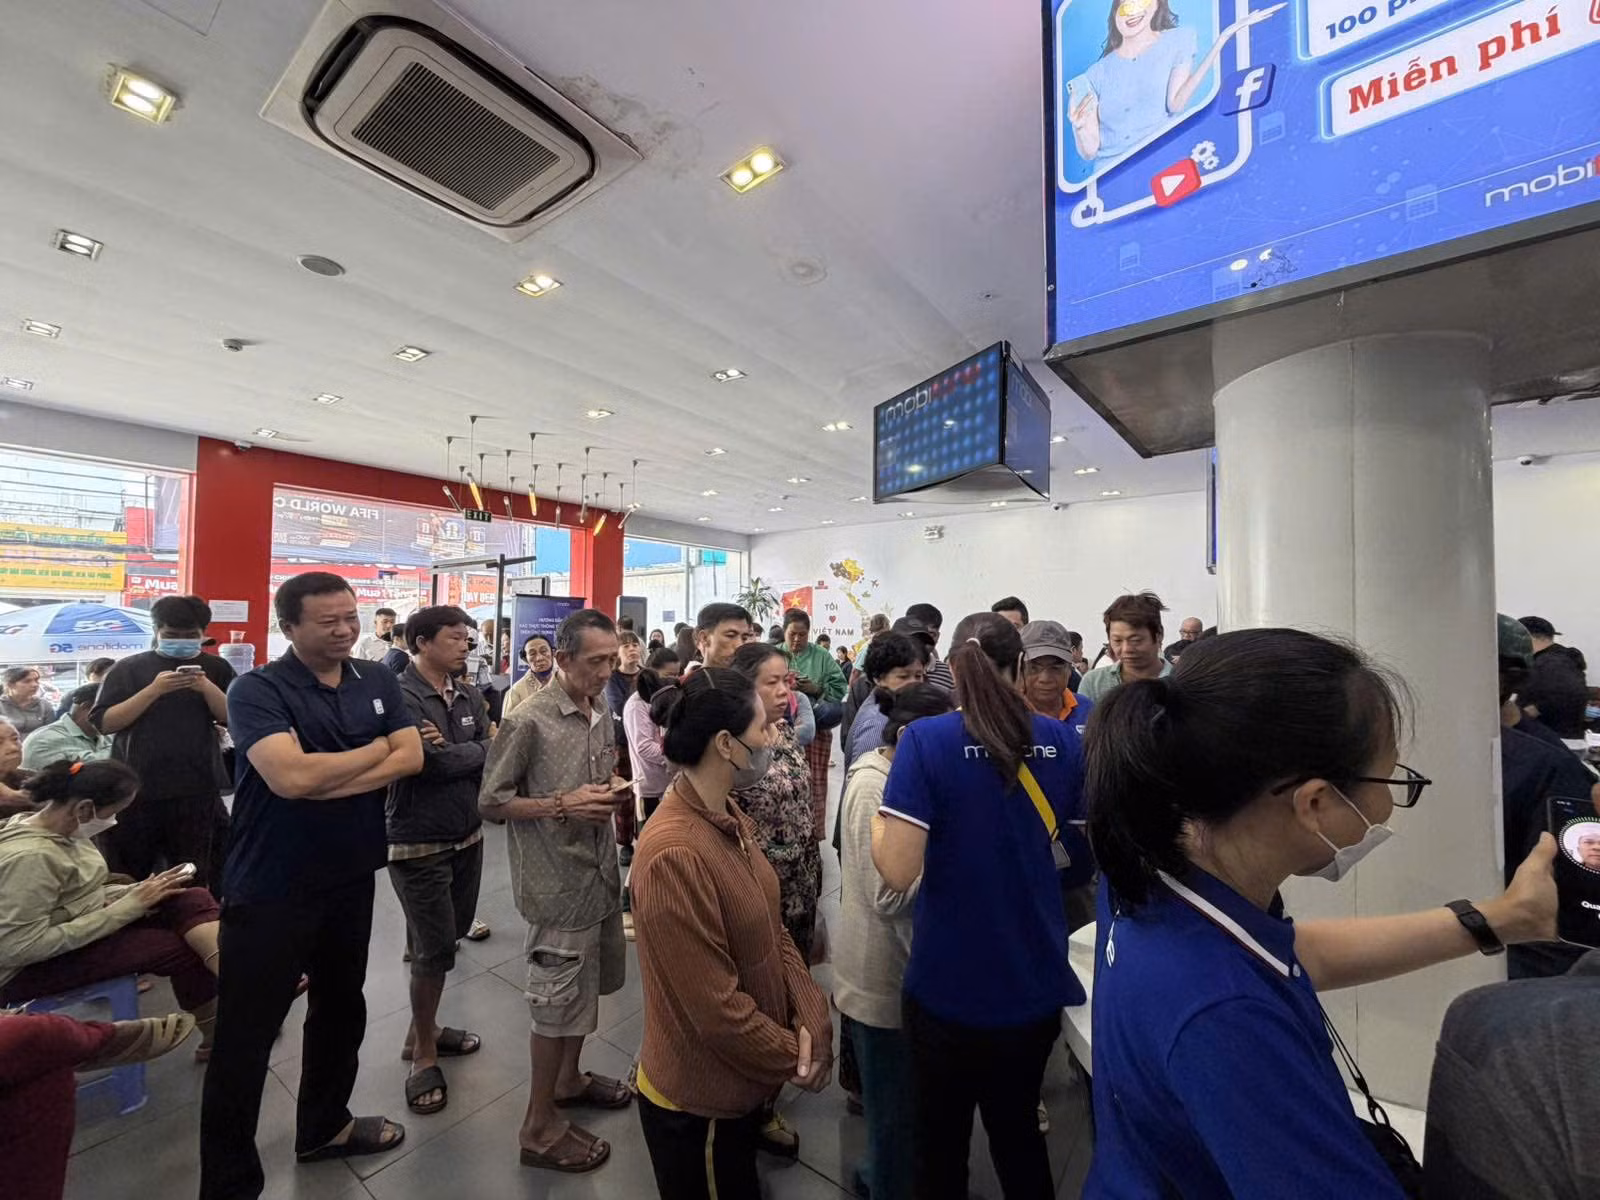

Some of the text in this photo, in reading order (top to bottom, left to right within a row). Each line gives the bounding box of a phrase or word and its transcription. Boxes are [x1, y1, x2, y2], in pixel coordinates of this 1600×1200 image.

[1326, 6, 1377, 39] 100
[1349, 4, 1561, 114] Miễn phí
[1485, 154, 1600, 208] mobi
[467, 511, 489, 521] EXIT
[824, 602, 838, 611] TÔI
[835, 628, 854, 636] NAM
